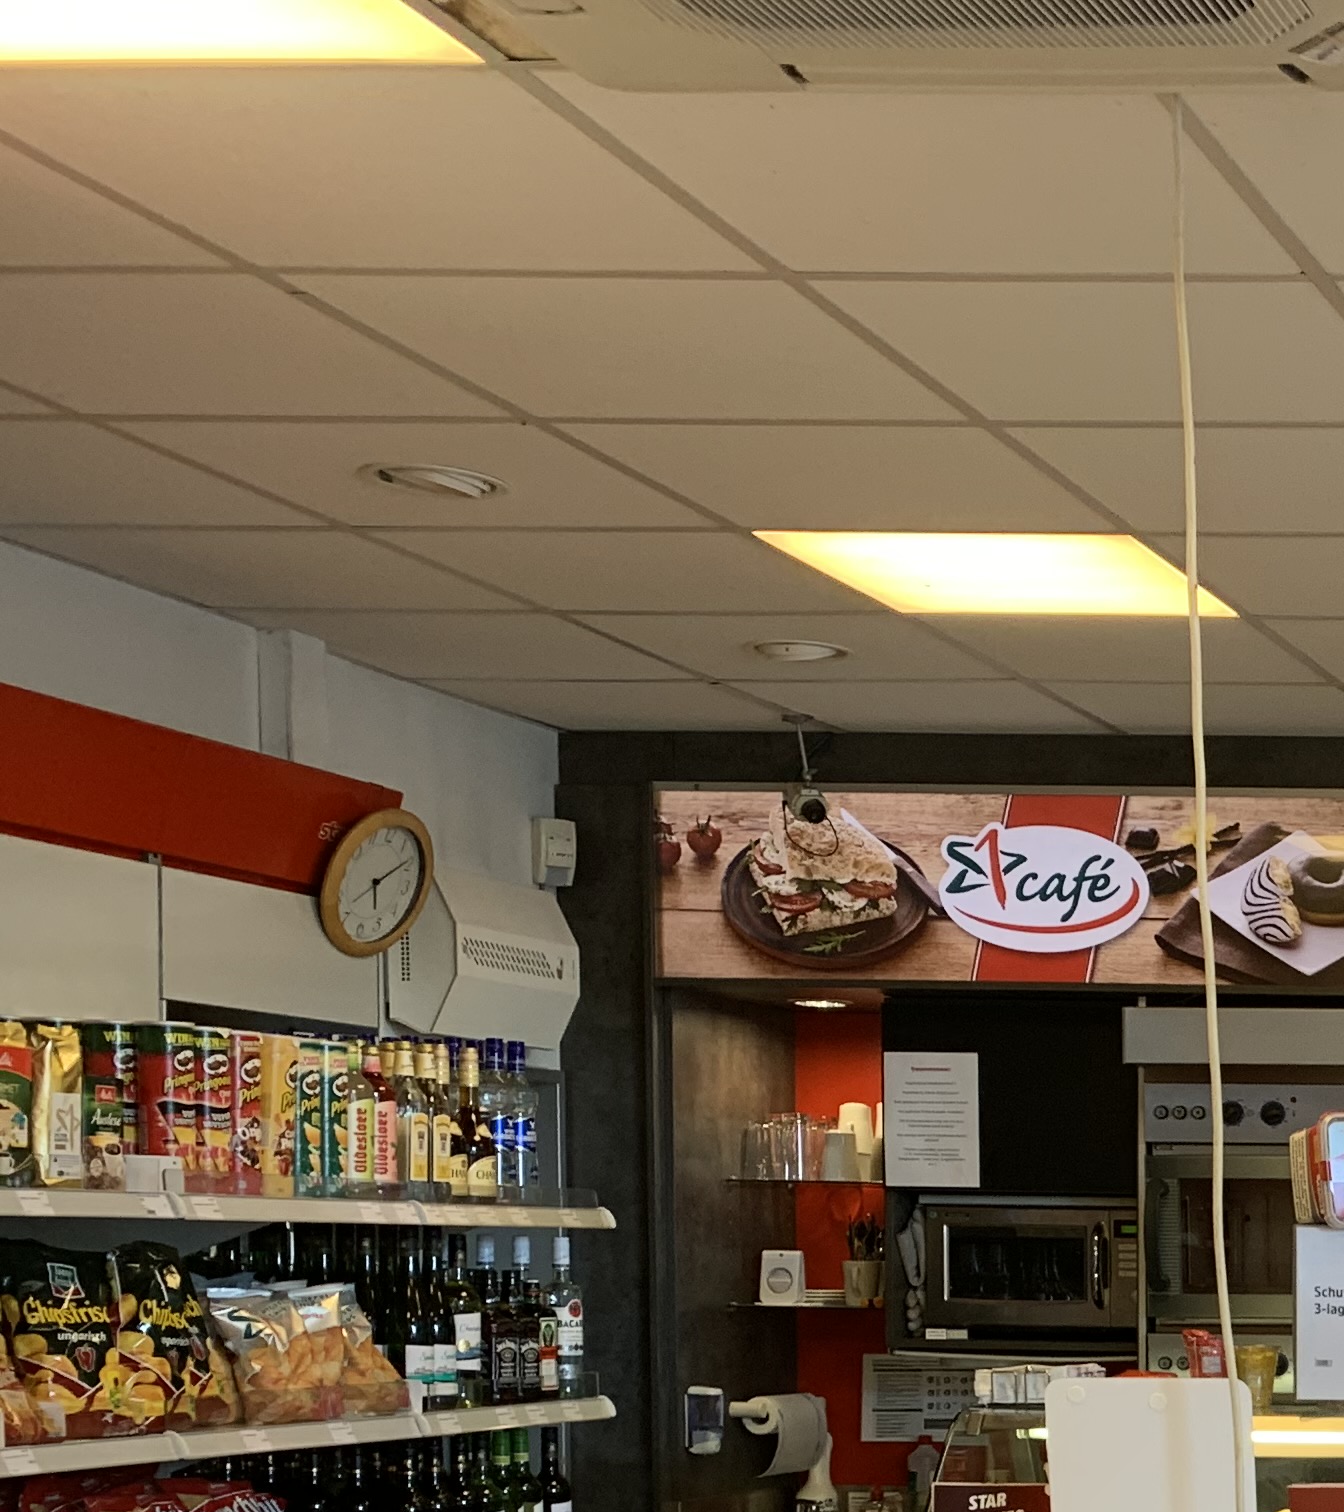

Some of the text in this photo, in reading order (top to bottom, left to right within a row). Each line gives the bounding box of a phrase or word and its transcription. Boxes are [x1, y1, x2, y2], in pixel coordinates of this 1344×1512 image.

[1016, 853, 1122, 922] café
[354, 1108, 367, 1174] Oldesloer
[374, 1110, 388, 1176] Oldesloer
[968, 1492, 1007, 1511] STAR
